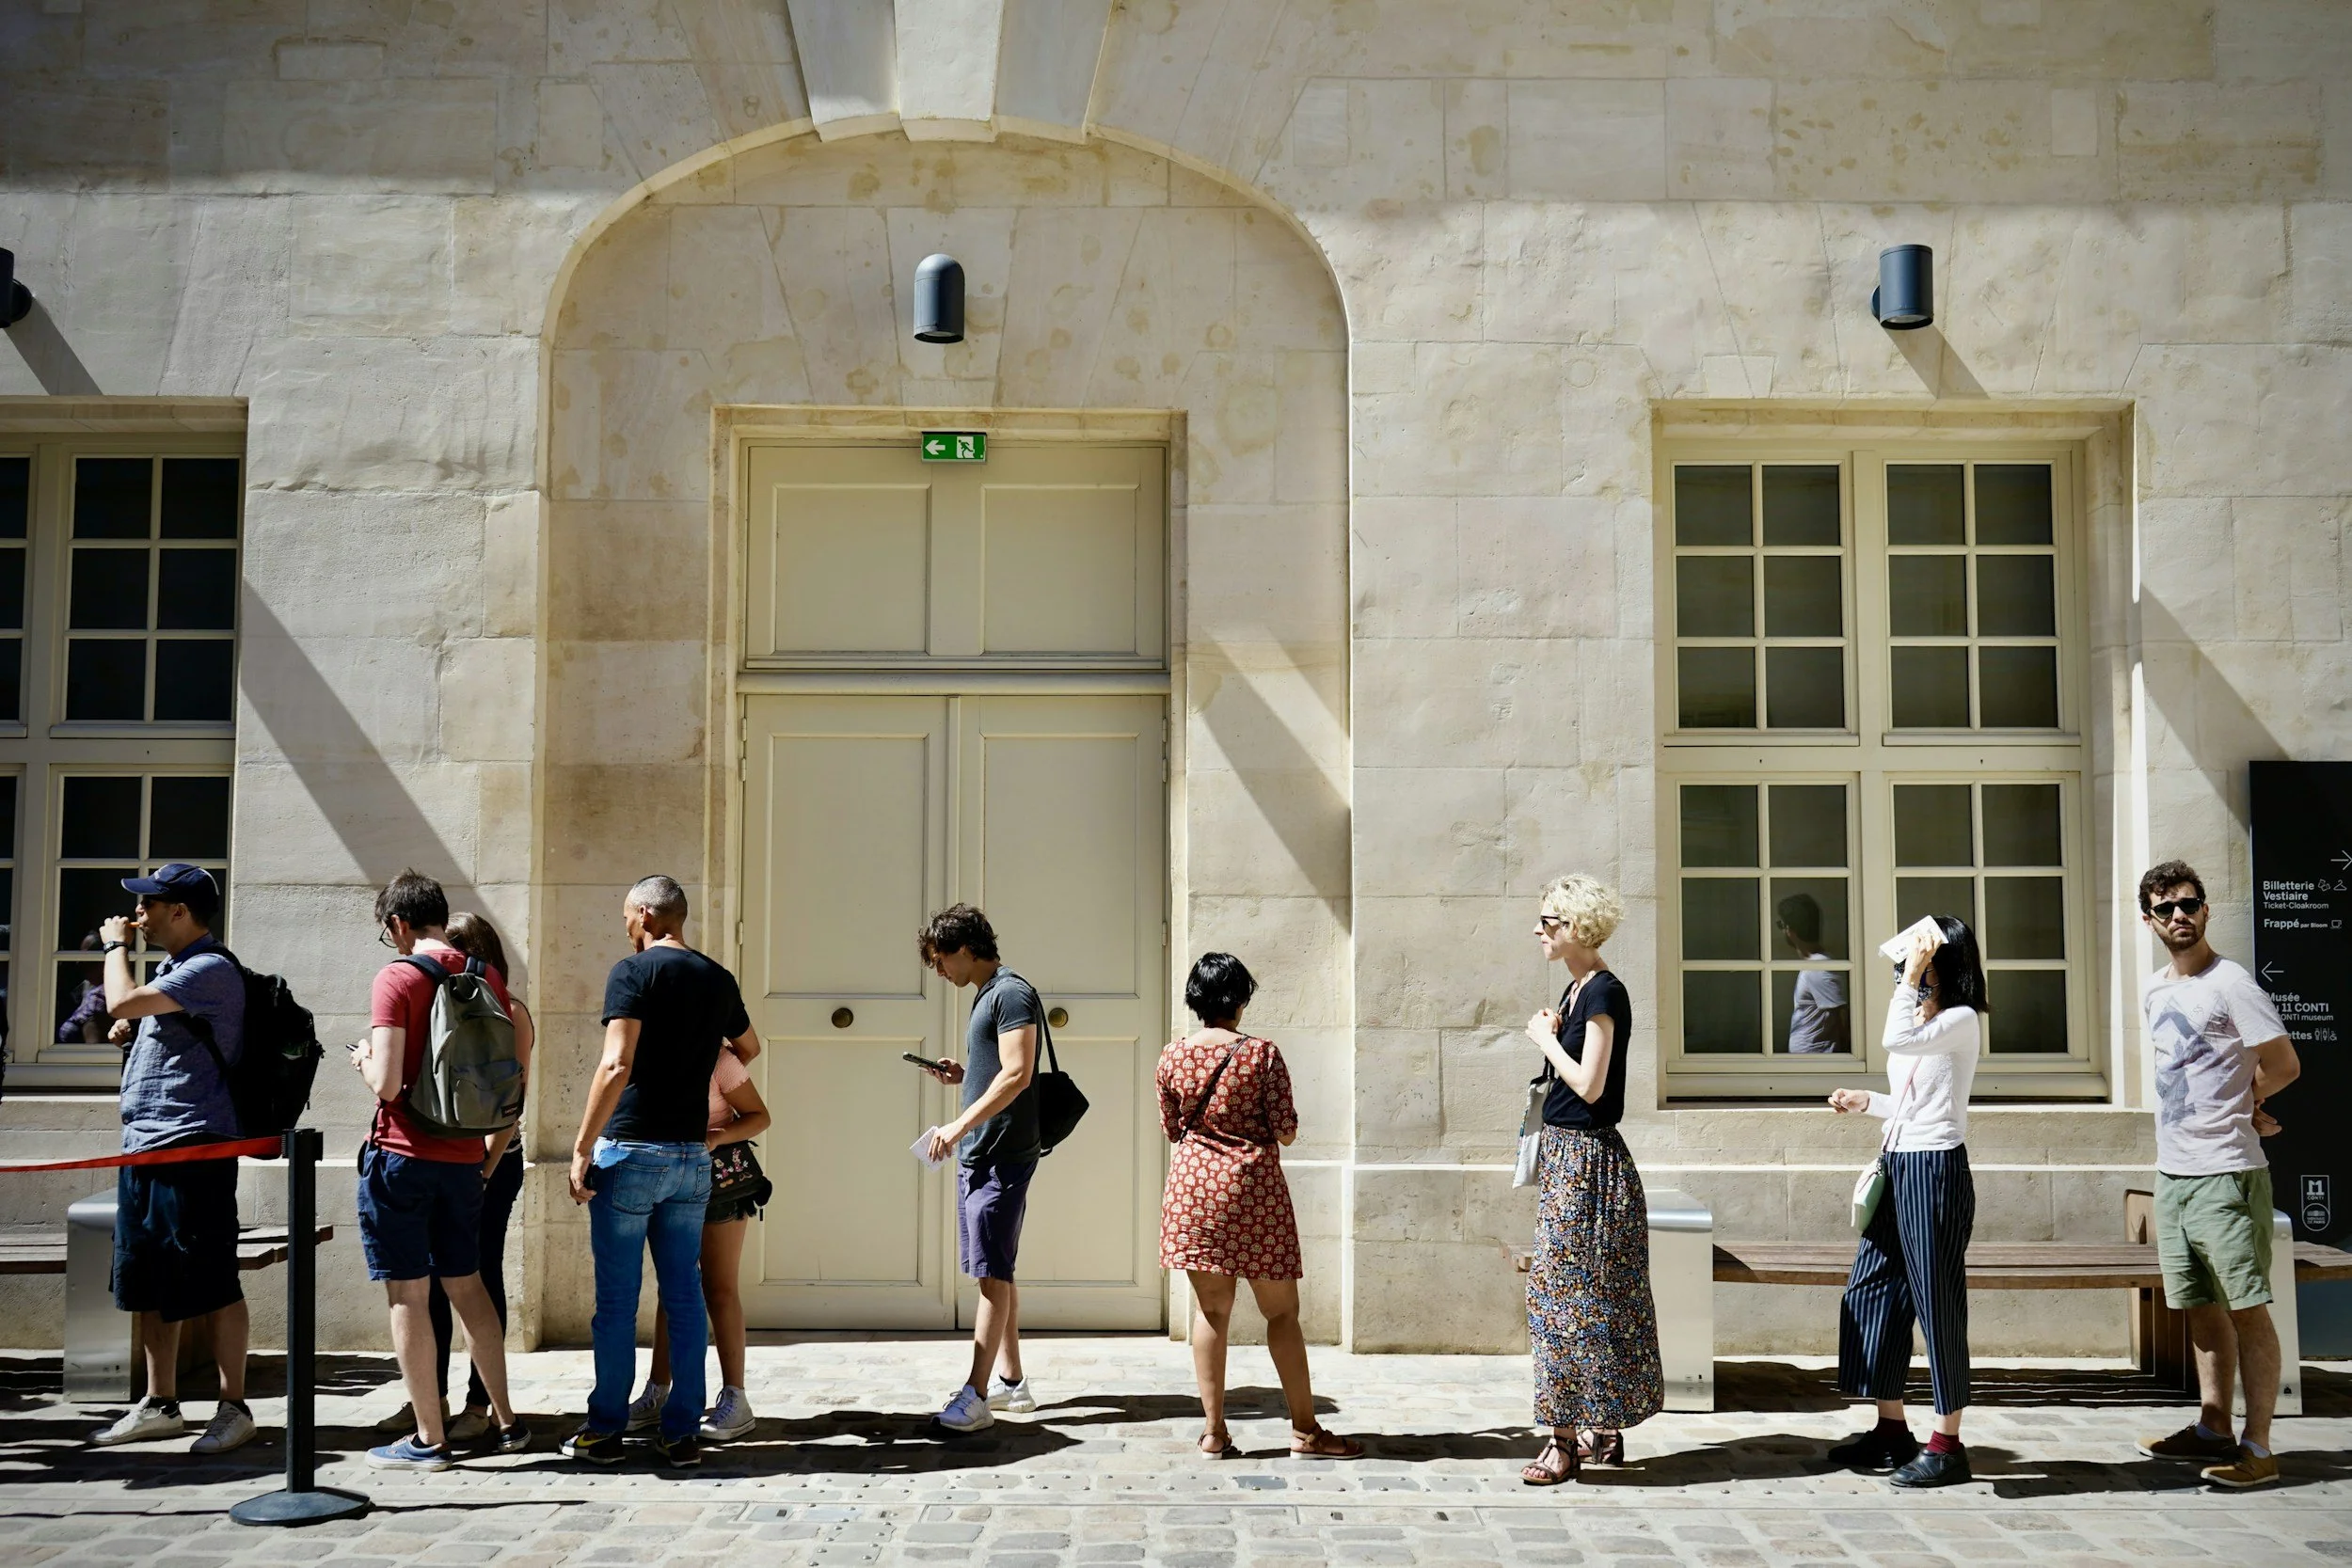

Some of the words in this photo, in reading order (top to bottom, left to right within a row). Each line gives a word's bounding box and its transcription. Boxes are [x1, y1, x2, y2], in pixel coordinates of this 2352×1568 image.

[2263, 880, 2314, 891] Billetterie
[2263, 891, 2309, 900] Vestiaire
[2263, 901, 2329, 910] Ticket-Cloakroom
[2264, 918, 2299, 929] Frappé
[2281, 1003, 2292, 1012] 11
[2295, 1003, 2328, 1012] CONTI
[2280, 1013, 2300, 1022] ONTI
